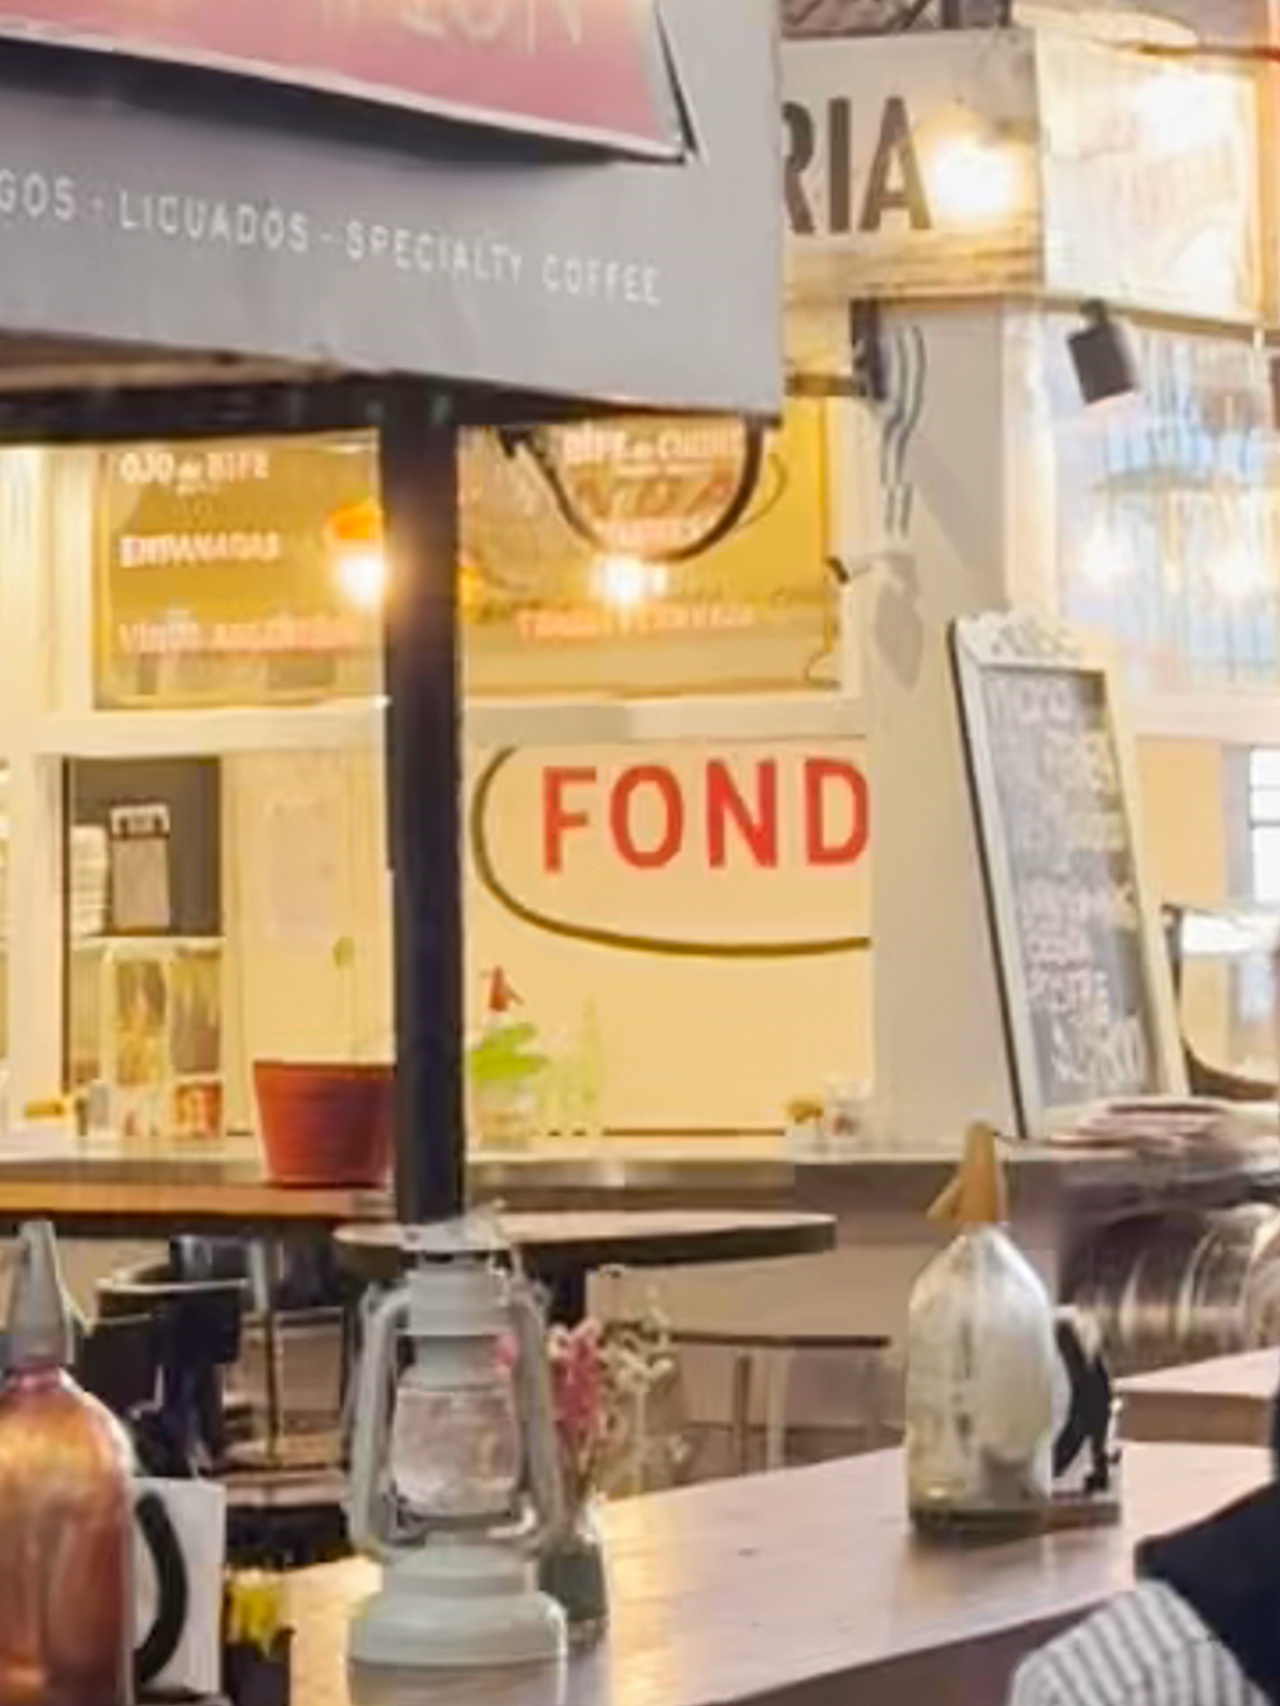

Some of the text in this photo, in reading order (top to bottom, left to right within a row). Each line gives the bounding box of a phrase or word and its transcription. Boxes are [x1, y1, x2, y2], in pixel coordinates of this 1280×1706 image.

[119, 190, 310, 253] LICUADOS
[345, 219, 522, 284] SPECIALTY
[541, 252, 661, 307] COFFEE
[542, 758, 869, 875] FOND
